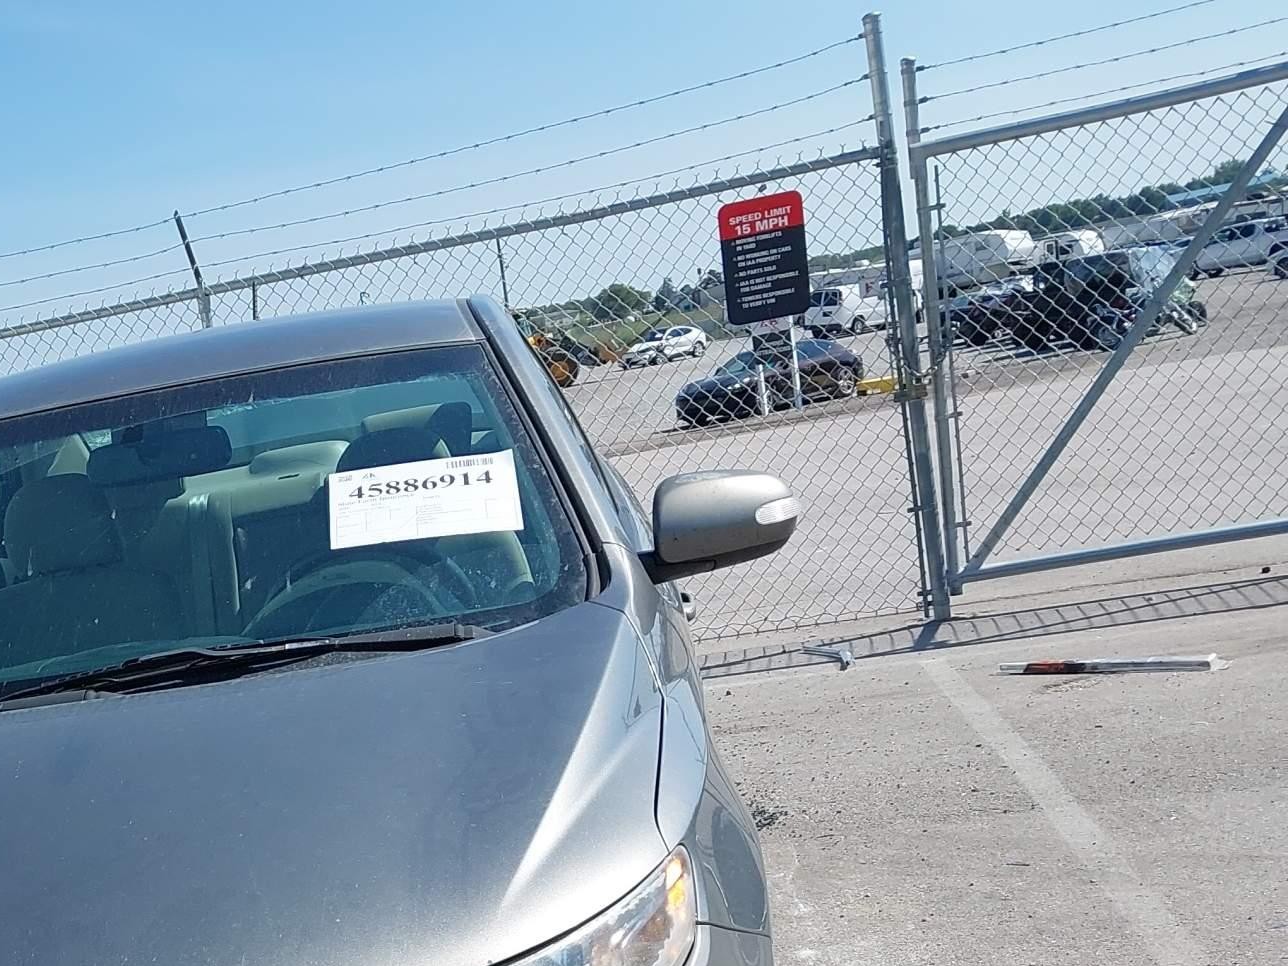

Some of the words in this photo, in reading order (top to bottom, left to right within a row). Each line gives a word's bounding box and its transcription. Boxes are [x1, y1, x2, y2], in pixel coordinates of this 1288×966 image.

[729, 212, 761, 225] SPEED
[765, 205, 792, 218] LIMIT
[735, 223, 751, 235] 15
[755, 215, 789, 232] MPH
[778, 245, 791, 253] CARS
[755, 254, 781, 264] PROPERTY
[747, 267, 763, 275] PARTS
[766, 270, 799, 281] RESPONSIBLE
[750, 282, 772, 291] DAMAGE
[349, 470, 493, 499] 45886914
